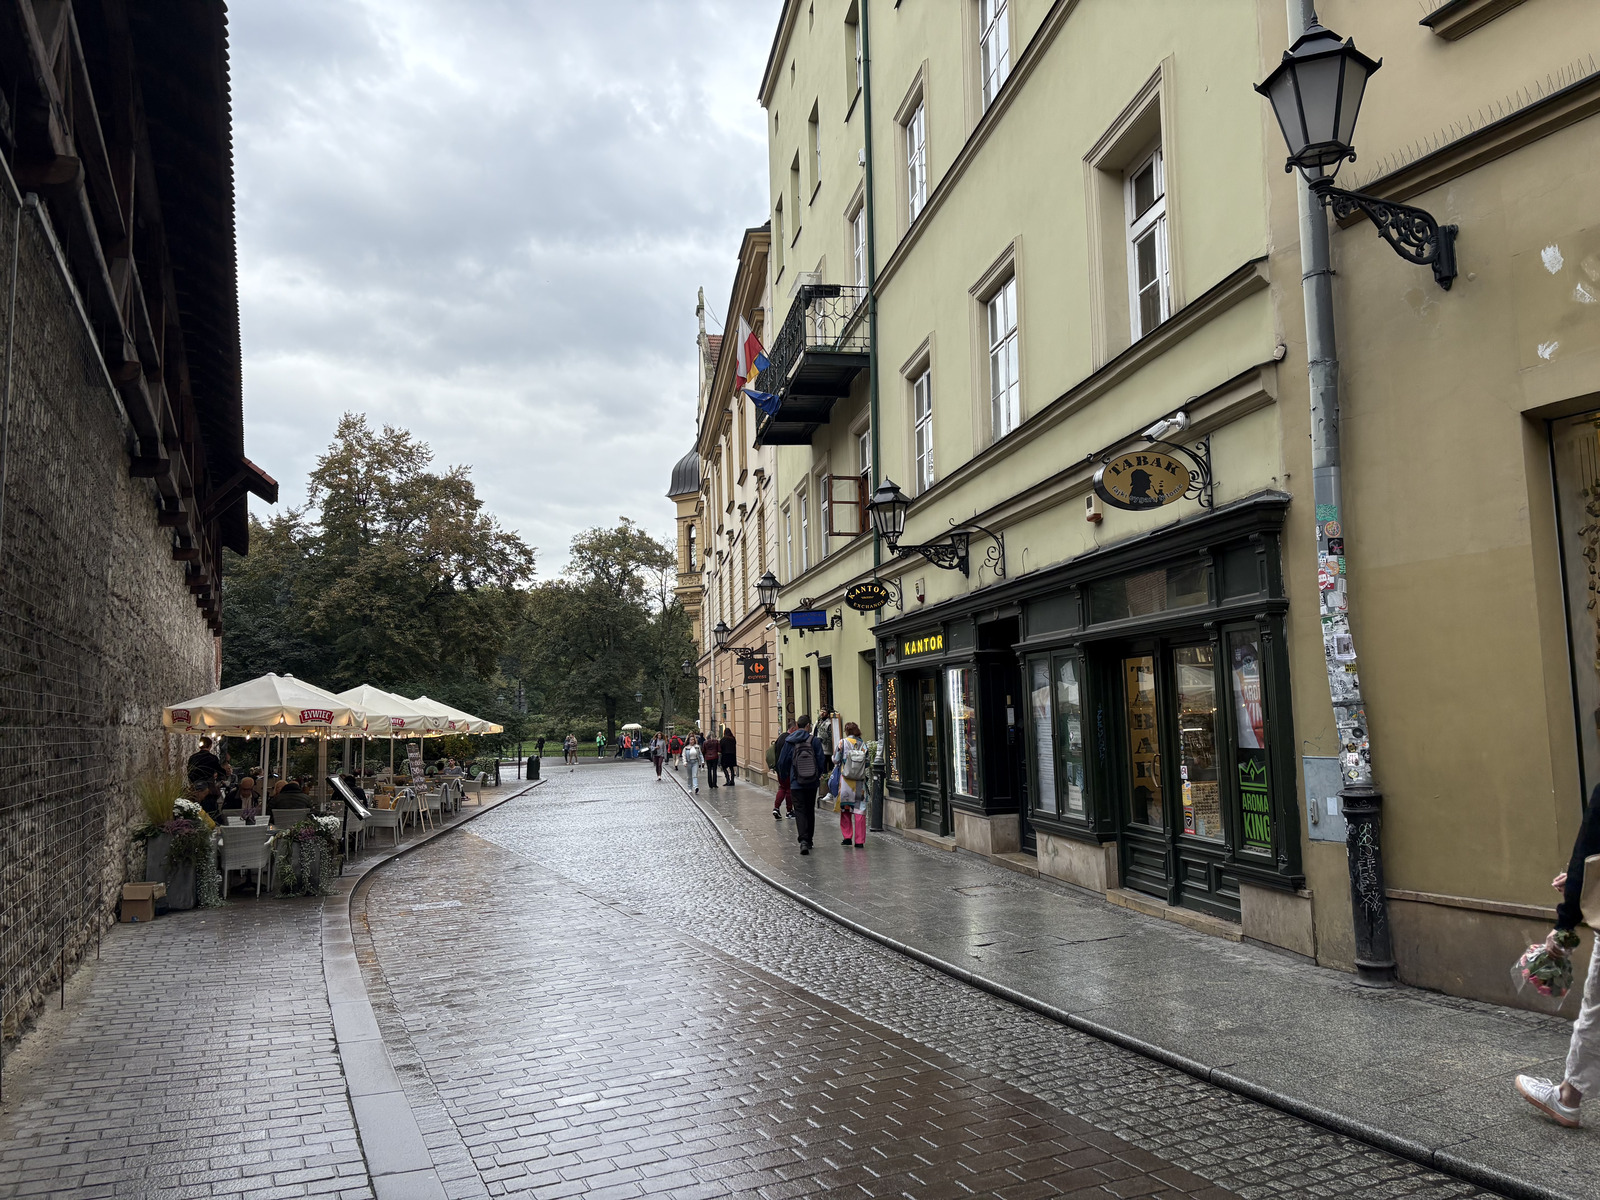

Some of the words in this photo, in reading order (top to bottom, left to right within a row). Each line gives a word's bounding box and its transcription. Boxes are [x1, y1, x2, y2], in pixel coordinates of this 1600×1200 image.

[1108, 456, 1180, 476] TABAK
[848, 585, 887, 599] KANTOR
[853, 599, 885, 609] EXCHANGE
[904, 634, 943, 656] KANTOR
[1243, 684, 1261, 701] ARO
[304, 709, 331, 721] ŻYWIEC
[1130, 665, 1159, 779] TABAK
[1242, 792, 1270, 813] AROMA
[1243, 812, 1271, 842] KING
